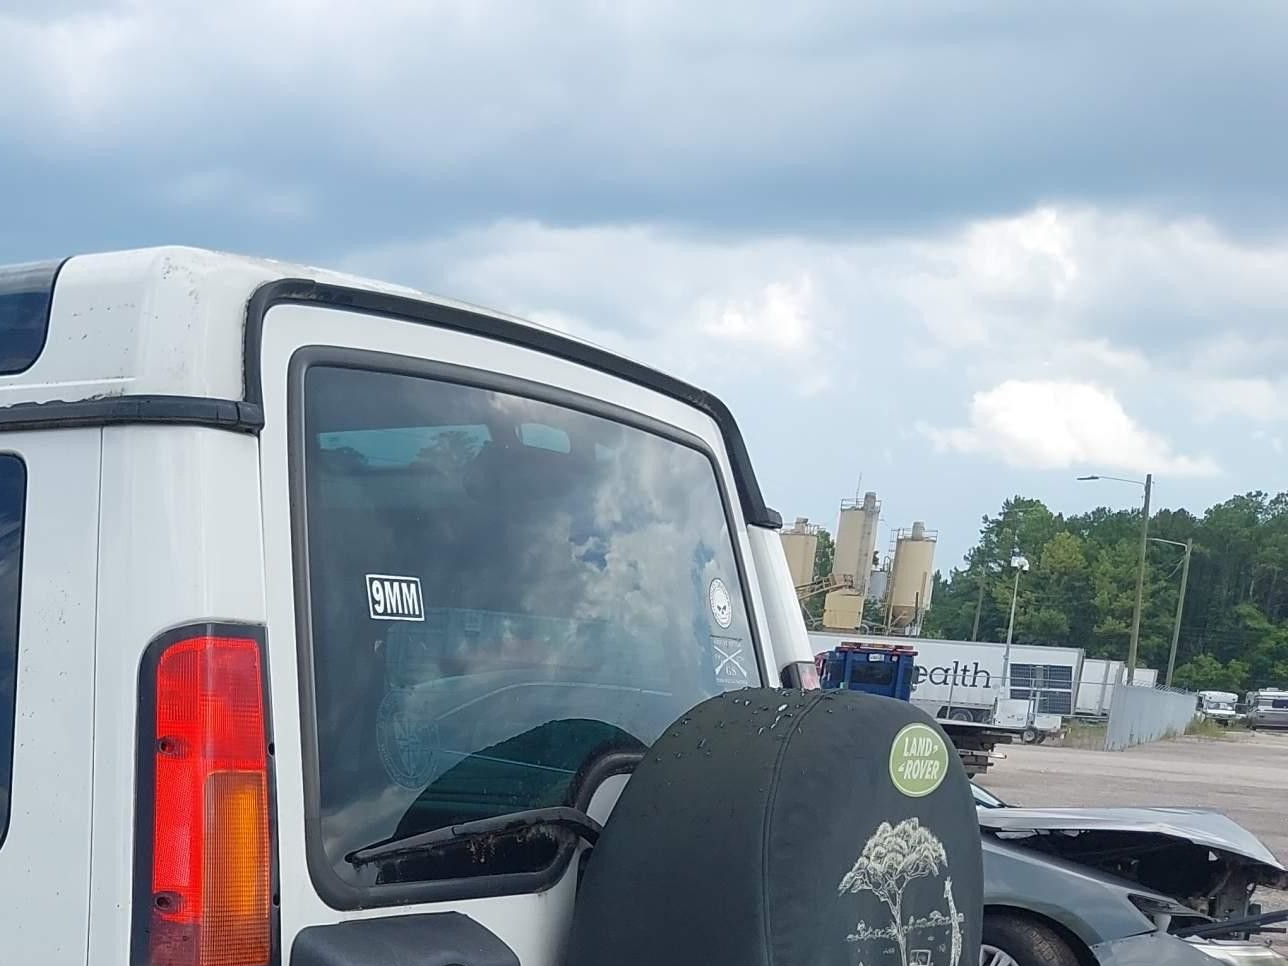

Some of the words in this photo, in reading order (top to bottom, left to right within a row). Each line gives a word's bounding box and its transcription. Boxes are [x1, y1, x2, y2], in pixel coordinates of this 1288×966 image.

[372, 580, 419, 615] 9MM
[916, 661, 992, 689] ealth
[903, 736, 933, 757] LAND
[903, 759, 940, 780] ROVER
